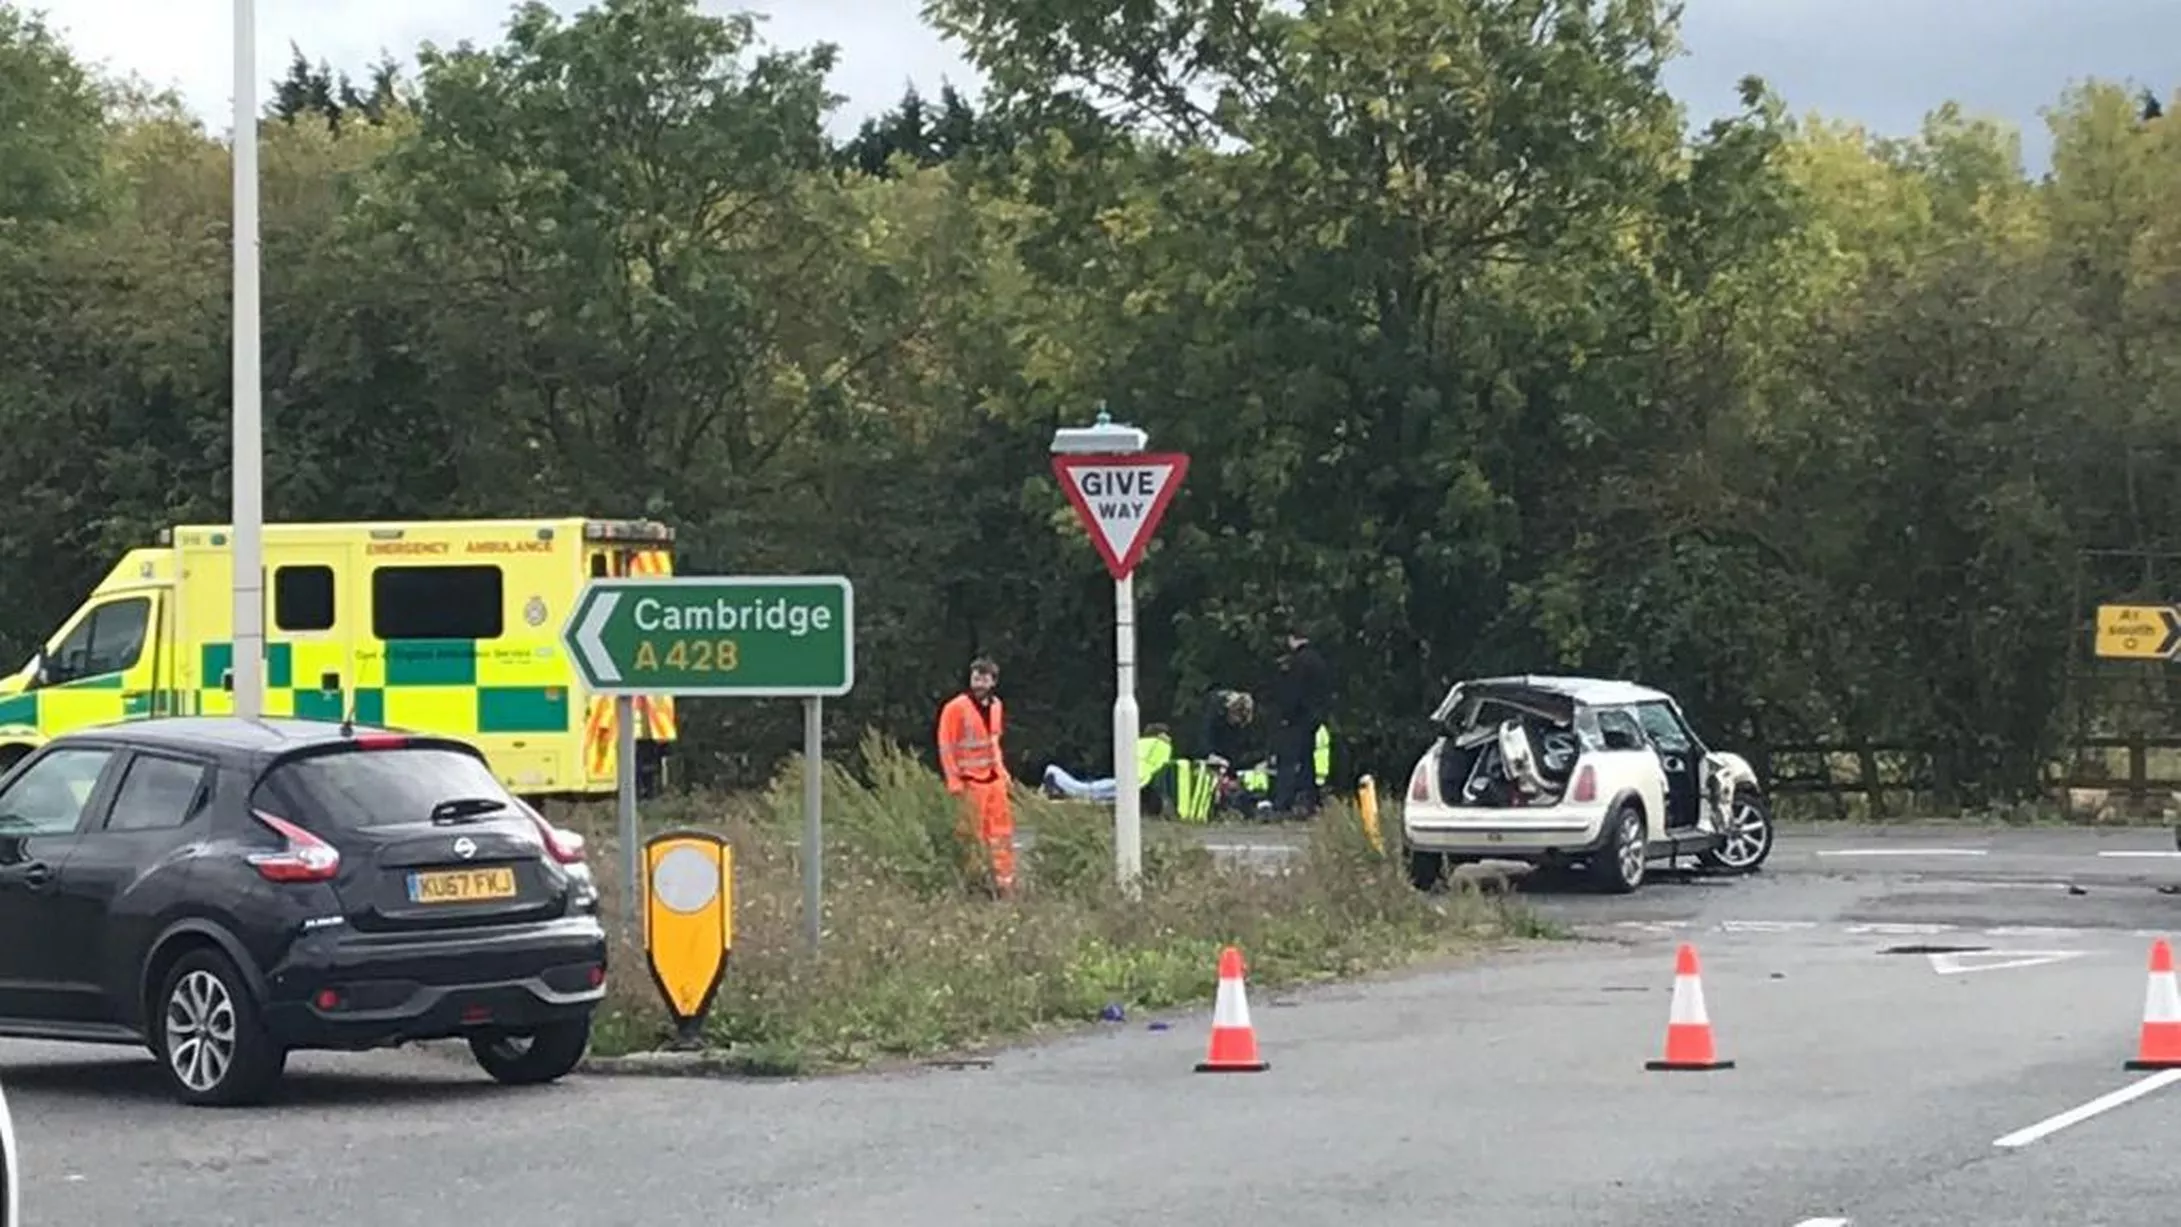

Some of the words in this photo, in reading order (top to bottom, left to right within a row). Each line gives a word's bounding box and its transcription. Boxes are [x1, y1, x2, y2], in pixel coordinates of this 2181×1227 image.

[1081, 471, 1155, 496] GIVE
[1098, 502, 1144, 519] WAY
[366, 541, 449, 555] EMERGENCY
[465, 540, 553, 554] AMBULANCE
[634, 597, 832, 636] Cambridge
